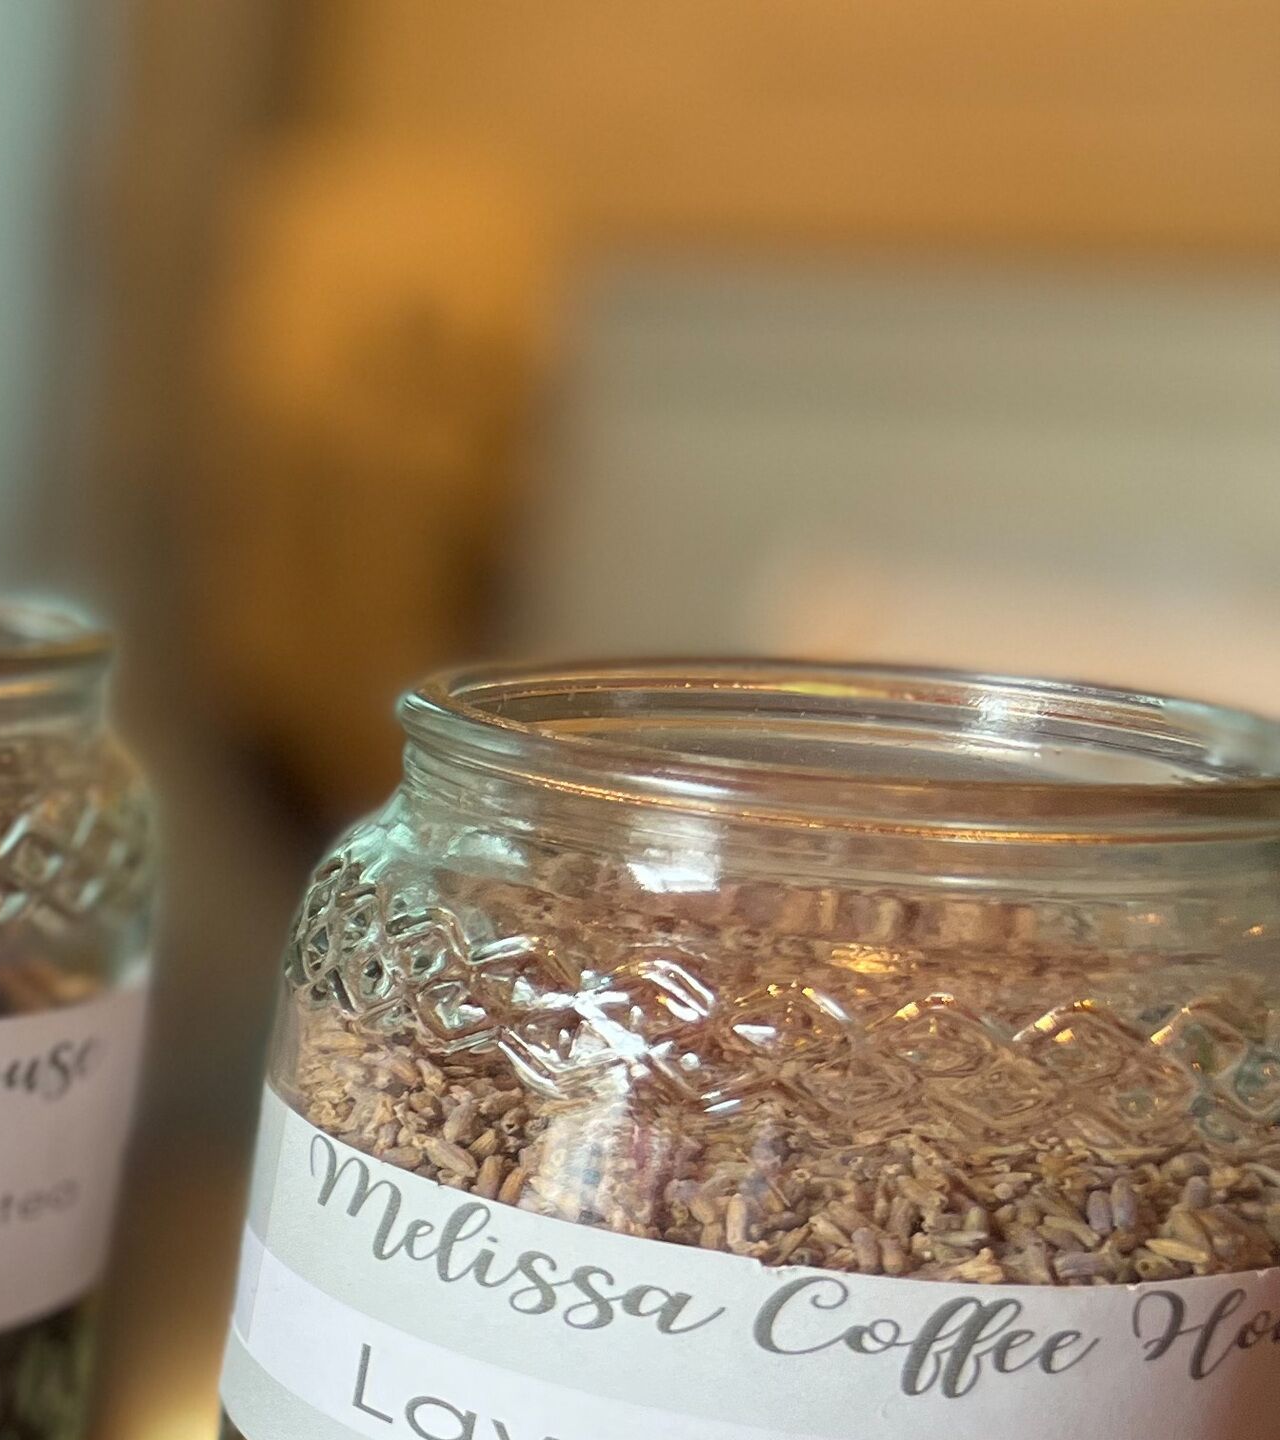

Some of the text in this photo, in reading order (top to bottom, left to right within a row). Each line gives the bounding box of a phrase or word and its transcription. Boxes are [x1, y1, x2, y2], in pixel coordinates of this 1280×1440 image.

[307, 1132, 1280, 1398] Melissa Coffee Ho
